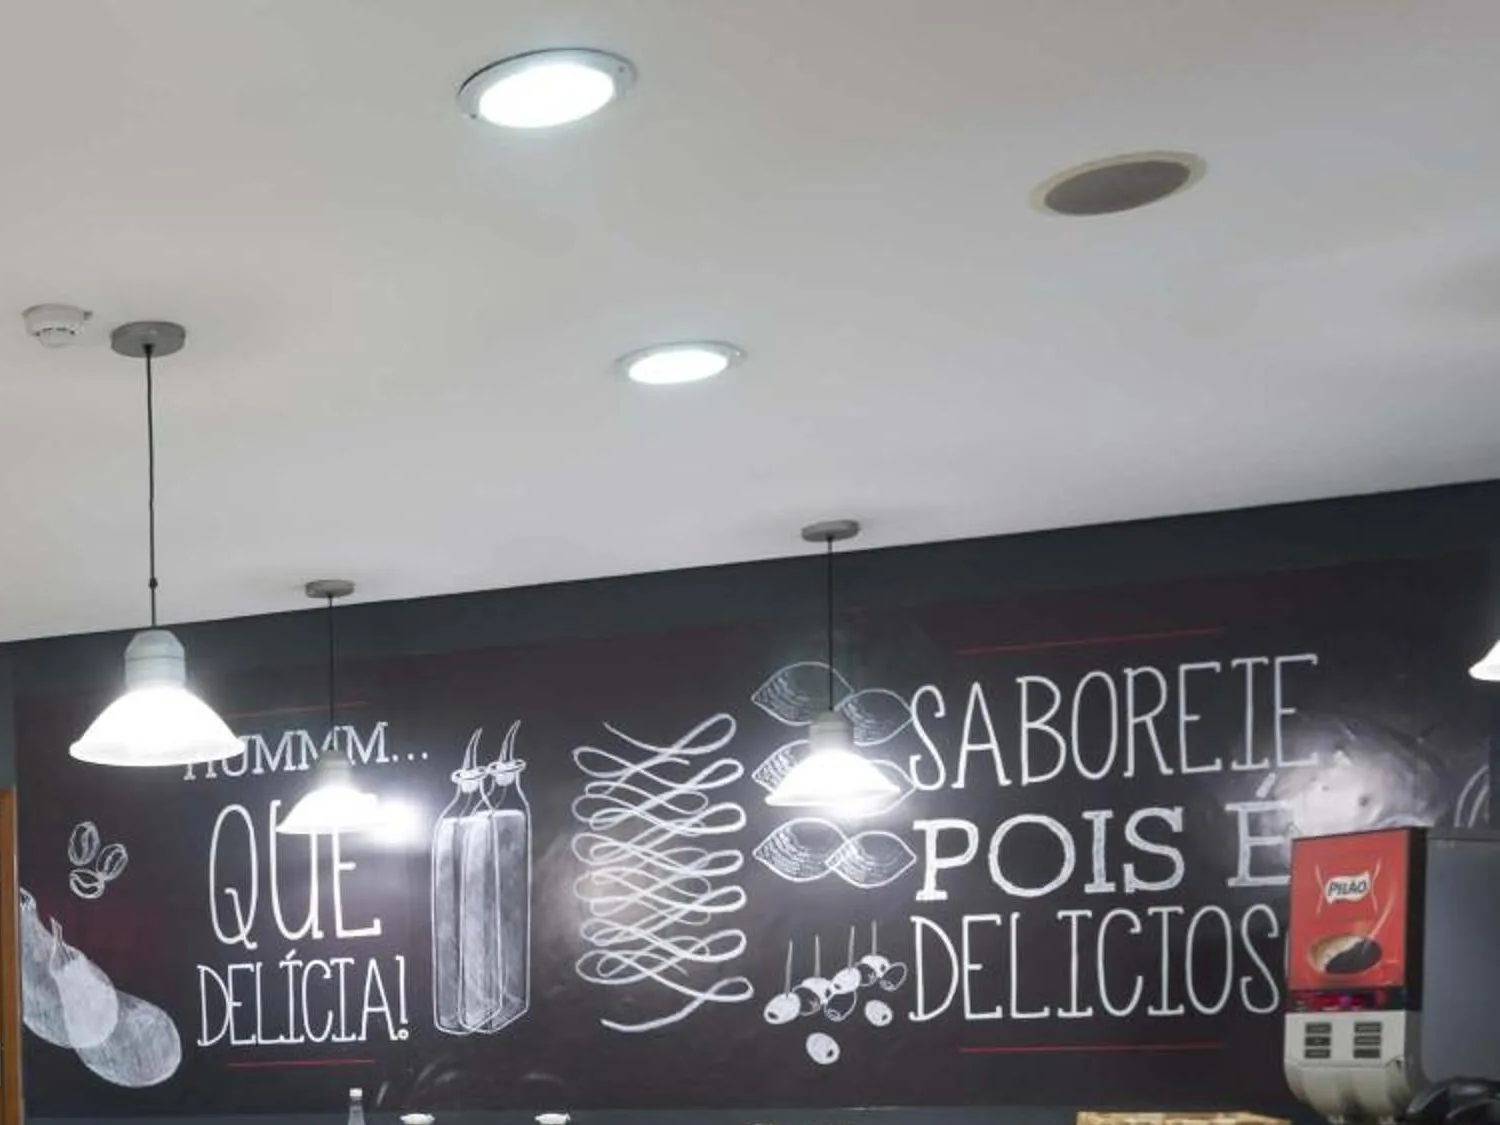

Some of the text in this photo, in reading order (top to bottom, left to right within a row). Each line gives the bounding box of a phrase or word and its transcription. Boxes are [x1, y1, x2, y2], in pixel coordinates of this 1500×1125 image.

[208, 799, 382, 949] QUE
[913, 806, 1186, 901] POIS
[196, 949, 410, 1046] DELÍCIA!
[908, 903, 1289, 1022] DELICIOS
